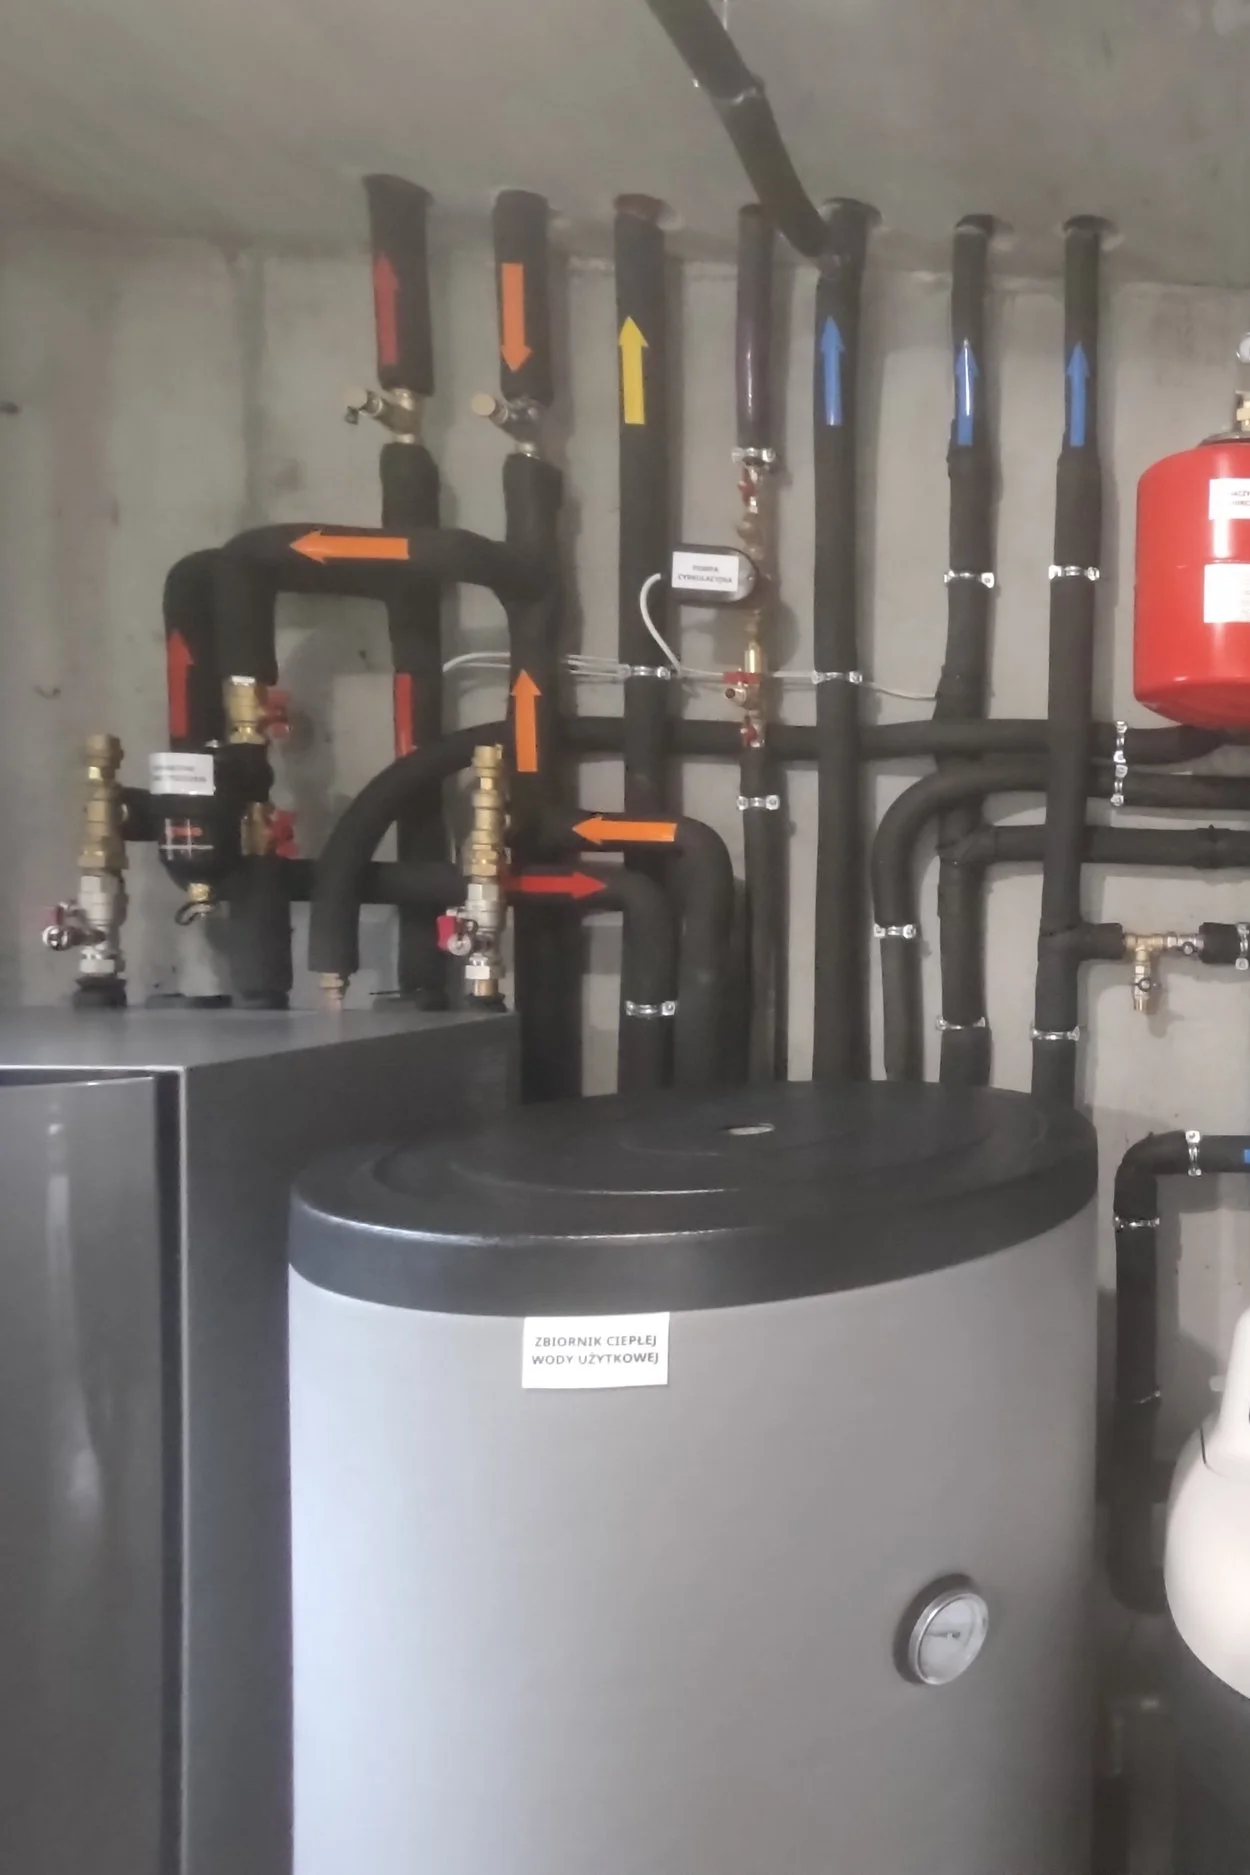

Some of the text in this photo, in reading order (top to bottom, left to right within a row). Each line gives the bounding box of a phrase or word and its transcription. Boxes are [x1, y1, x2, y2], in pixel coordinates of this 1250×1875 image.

[535, 1335, 657, 1347] ZBIORNIK CIEPŁEJ
[532, 1352, 659, 1365] WODY UŻYTKOWEJ
